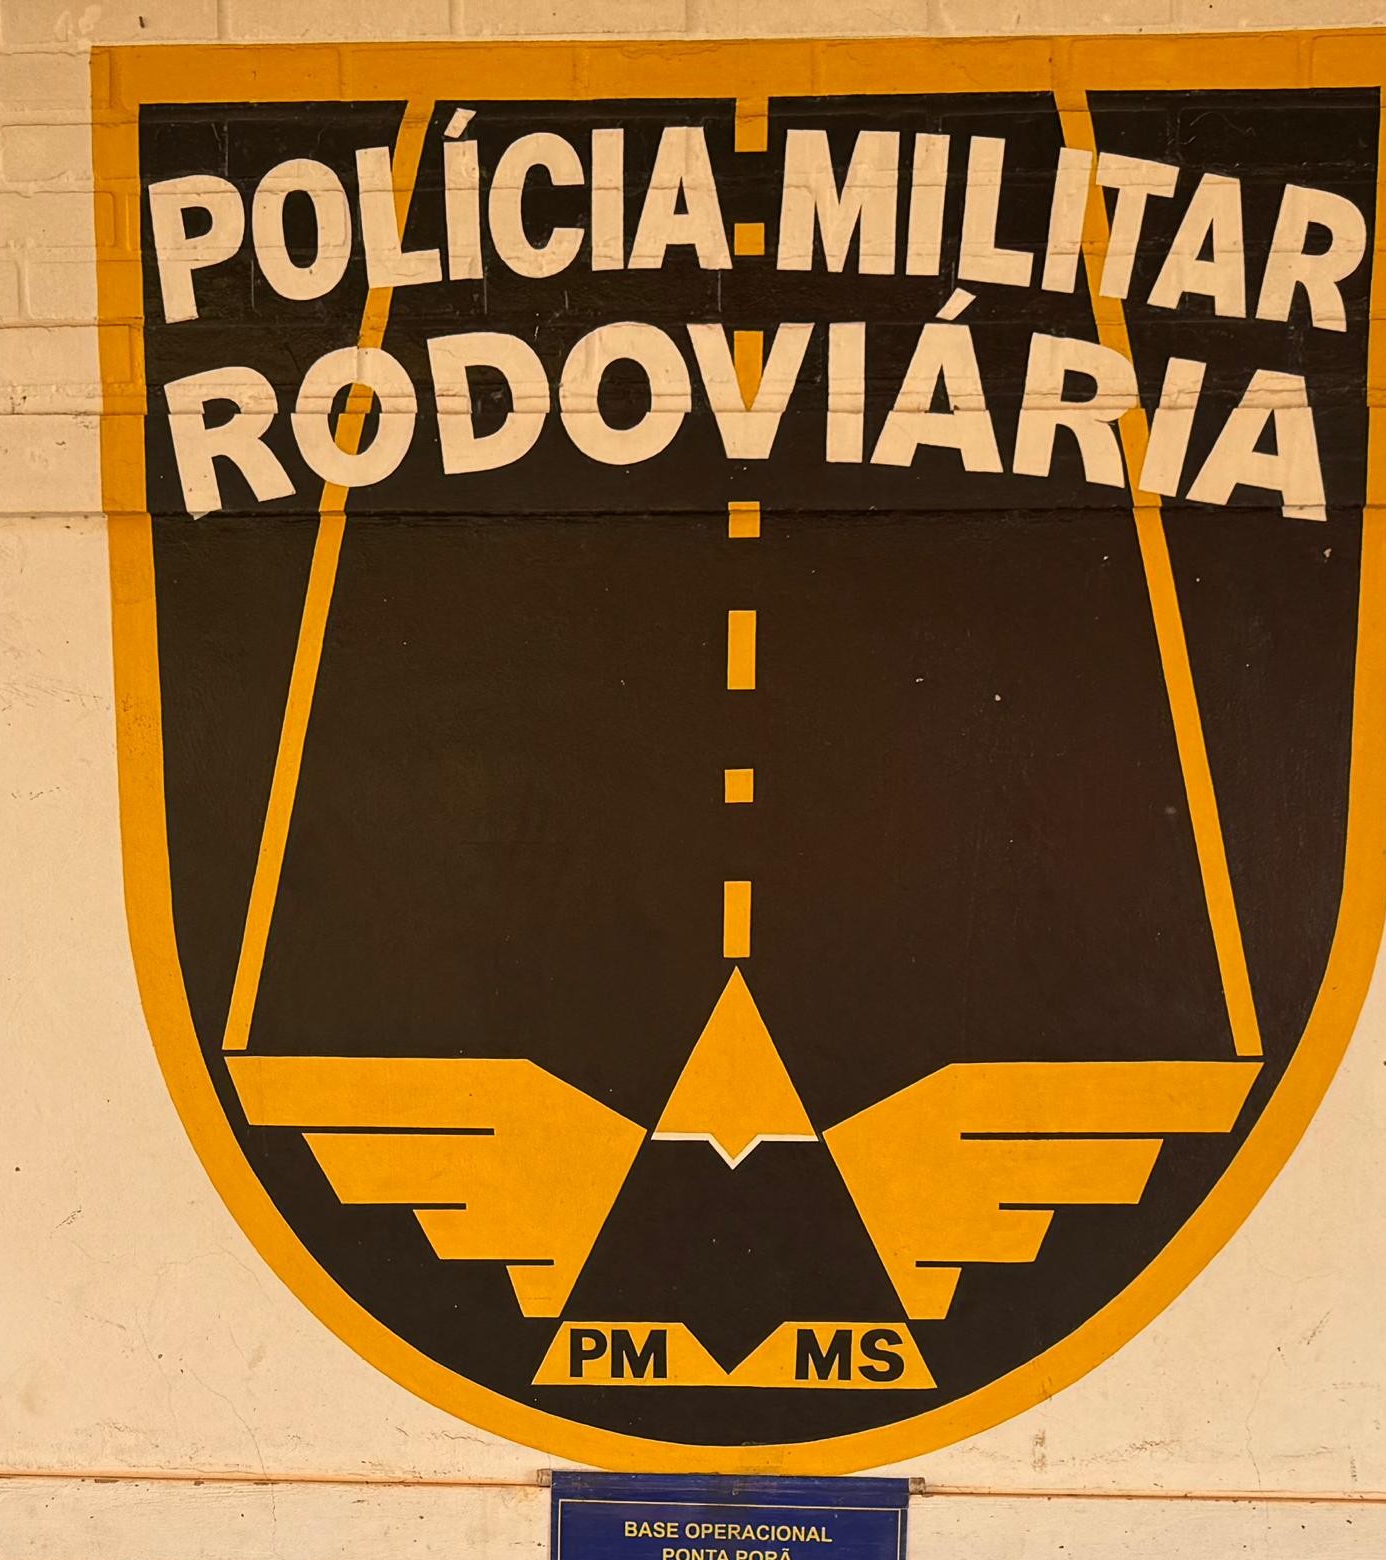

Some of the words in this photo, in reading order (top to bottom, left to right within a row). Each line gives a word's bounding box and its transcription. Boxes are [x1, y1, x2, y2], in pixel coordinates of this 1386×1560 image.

[147, 108, 732, 325] POLÍCIA
[776, 128, 1367, 333] MILITAR
[163, 288, 1327, 521] RODOVIÁRIA
[569, 1328, 667, 1379] PM
[794, 1327, 905, 1382] MS
[624, 1521, 679, 1539] BASE
[685, 1523, 833, 1543] OPERACIONAL
